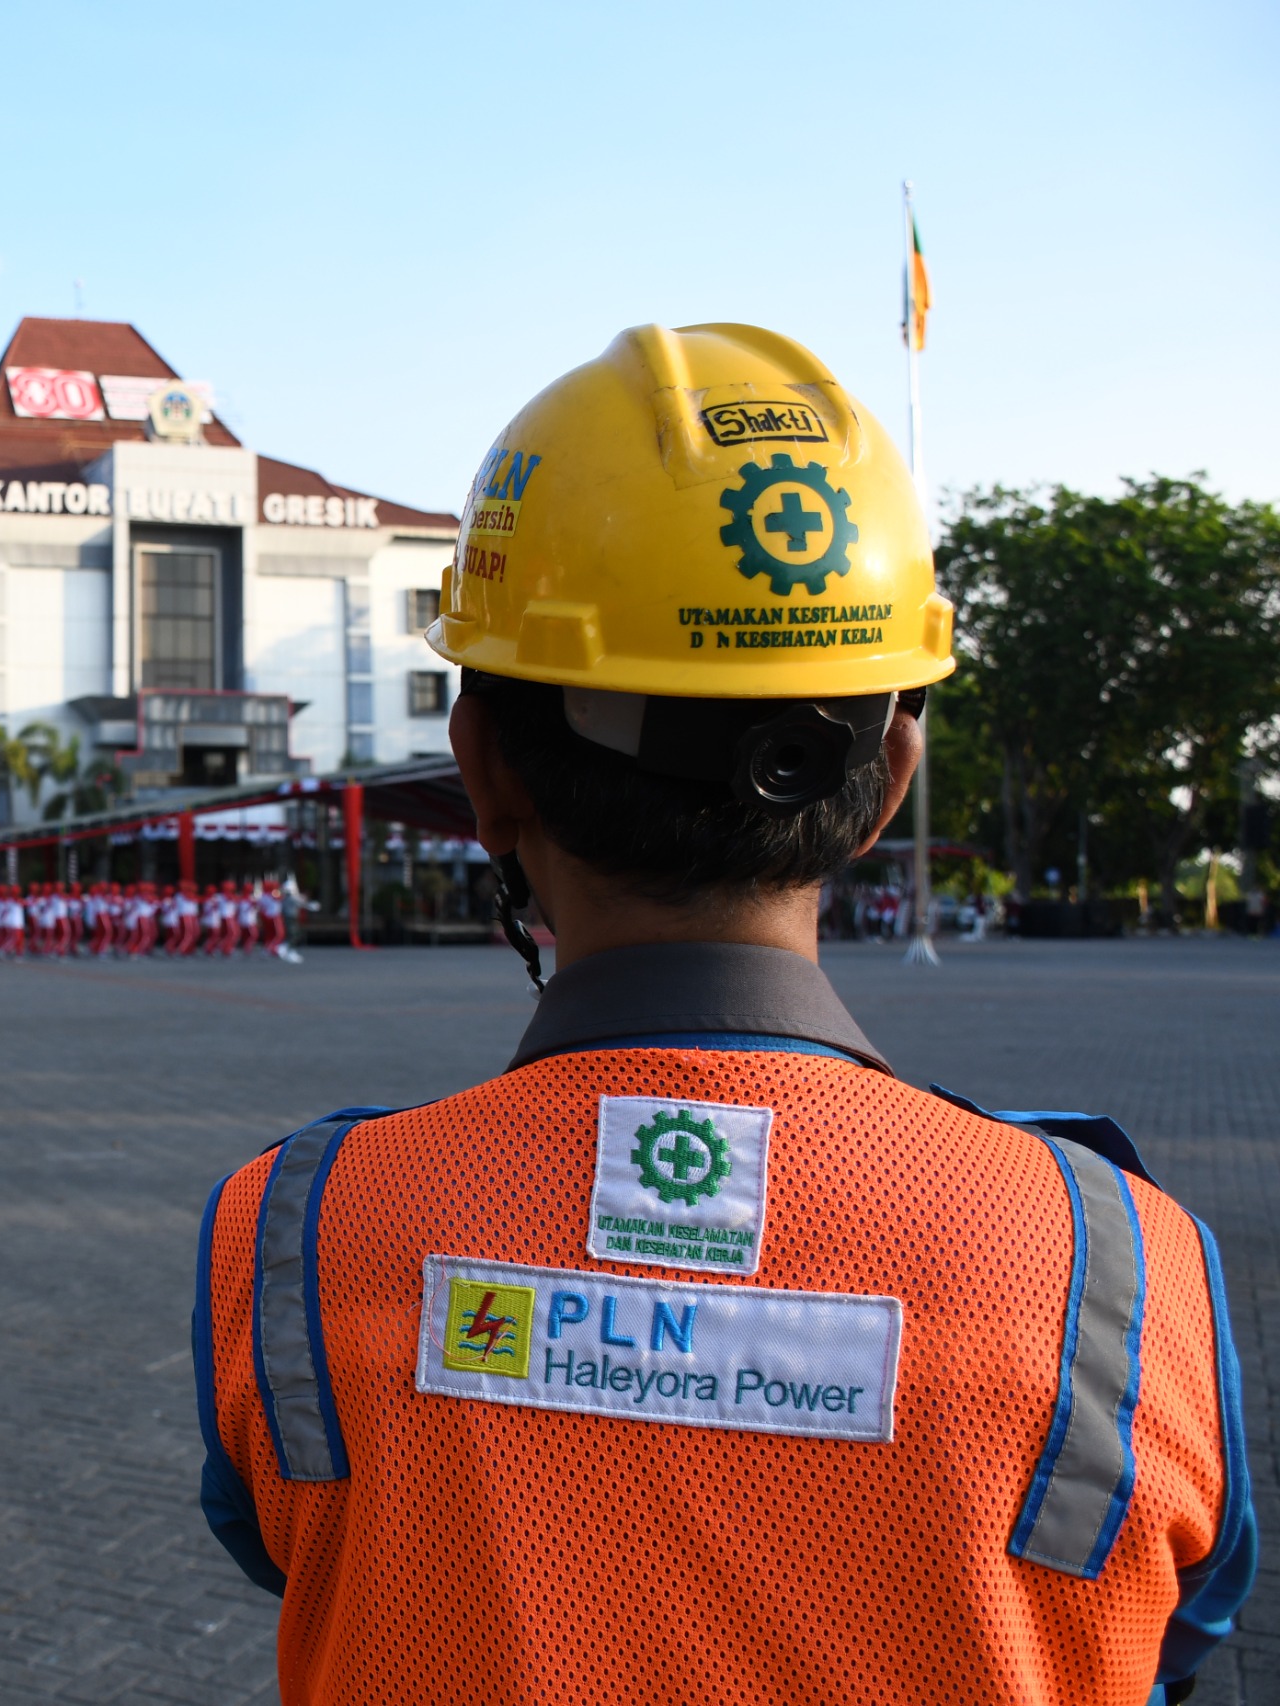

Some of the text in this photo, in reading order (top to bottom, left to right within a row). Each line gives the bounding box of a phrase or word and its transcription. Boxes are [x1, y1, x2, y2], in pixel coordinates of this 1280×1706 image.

[713, 408, 813, 437] Shakti
[128, 487, 246, 523] BUPATI
[263, 493, 380, 527] GRESIK
[678, 607, 783, 626] UTAMAKAN
[735, 629, 837, 648] KESEHATAN
[840, 627, 883, 645] KERJA
[597, 1215, 755, 1247] UTAMAKAN KESELAMATAN
[606, 1235, 744, 1264] DAN KESEHATAN KERJA
[547, 1290, 698, 1353] PLN
[544, 1347, 864, 1413] Haleyora Power
